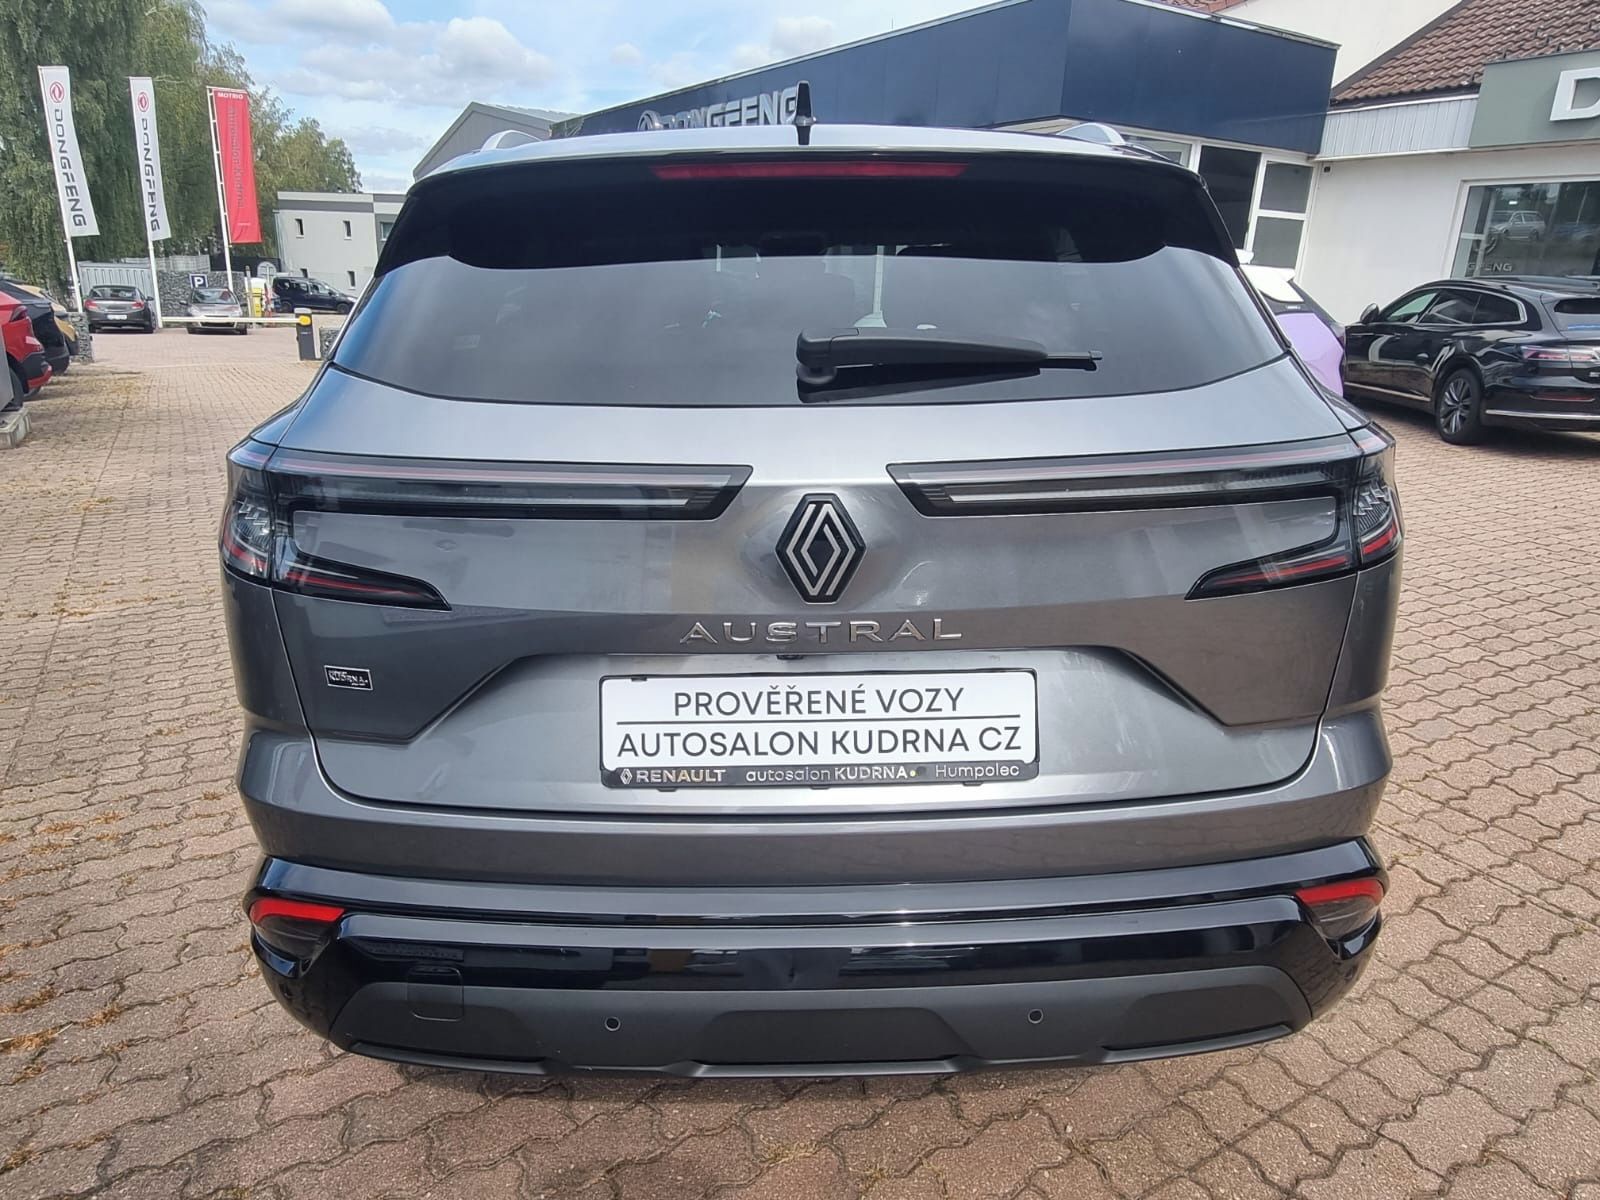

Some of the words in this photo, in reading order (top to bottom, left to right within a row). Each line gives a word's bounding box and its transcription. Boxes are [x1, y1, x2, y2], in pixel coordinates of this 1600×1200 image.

[217, 91, 244, 100] MOTRIO
[54, 108, 88, 228] DONGFENG
[141, 117, 161, 232] DONGFENG
[194, 278, 204, 288] P
[680, 618, 963, 644] AUSTRAL
[674, 684, 867, 716] PROVĚŘENÉ
[876, 687, 964, 713] VOZY
[617, 730, 819, 757] AUTOSALON
[831, 728, 969, 755] KUDRNA
[979, 726, 1021, 751] CZ
[635, 769, 726, 783] RENAULT
[745, 766, 831, 782] autosalon
[935, 763, 1020, 780] Humpolec
